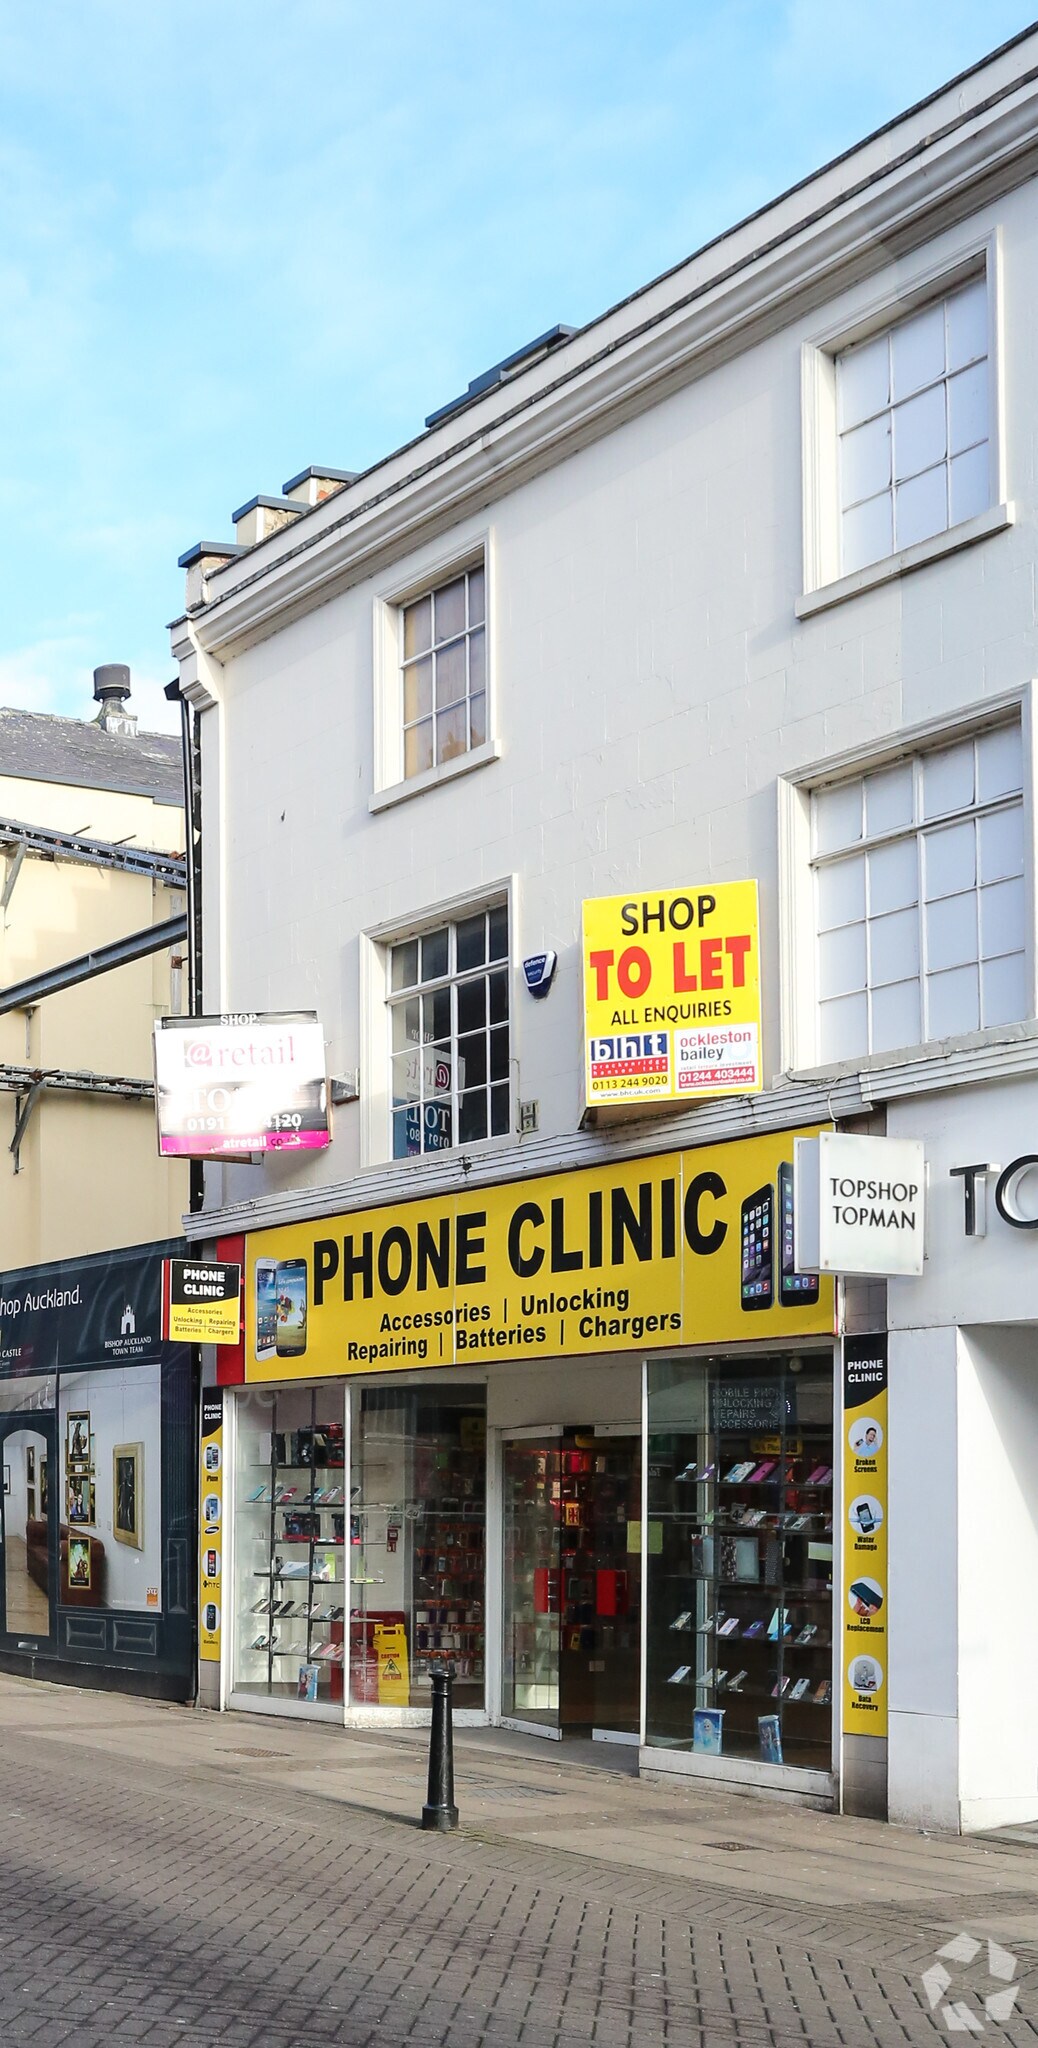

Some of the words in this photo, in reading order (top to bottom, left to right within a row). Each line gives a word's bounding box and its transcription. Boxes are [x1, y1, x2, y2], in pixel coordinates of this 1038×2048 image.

[622, 894, 716, 936] SHOP
[590, 945, 652, 1001] TO
[673, 935, 751, 993] LET
[220, 1014, 259, 1026] SHOP
[611, 1010, 639, 1026] ALL
[645, 1000, 732, 1023] ENQUIRIES
[680, 1031, 752, 1048] ockleston
[592, 1034, 664, 1061] bht
[680, 1047, 724, 1061] bailey
[680, 1071, 712, 1083] 01244
[714, 1067, 754, 1080] 403444
[592, 1080, 618, 1091] 0113
[620, 1078, 639, 1088] 244
[642, 1075, 668, 1086] 9020
[187, 1117, 225, 1132] 0191
[830, 1177, 918, 1203] TOPSHOP
[832, 1206, 915, 1231] TOPMAN
[313, 1211, 487, 1306] PHONE
[507, 1171, 728, 1279] CLINIC
[183, 1268, 226, 1283] PHONE
[183, 1283, 225, 1297] CLINIC
[23, 1284, 83, 1312] Auckland.
[187, 1307, 223, 1315] Accessories
[379, 1302, 491, 1334] Accessories
[521, 1287, 630, 1316] Unlocking
[173, 1316, 203, 1325] Unlocking
[208, 1318, 236, 1327] Repairing
[174, 1325, 202, 1334] Batteries
[207, 1327, 234, 1336] Chargers
[347, 1333, 428, 1363] Repairing
[456, 1322, 547, 1350] Batteries
[578, 1311, 682, 1339] Chargers
[104, 1339, 123, 1349] BISHOP
[1, 1347, 22, 1358] CASTLE
[847, 1359, 883, 1371] PHONE
[848, 1372, 883, 1383] CLINIC
[203, 1403, 222, 1412] PHONE
[855, 1458, 876, 1466] Broken
[854, 1543, 877, 1551] Damage
